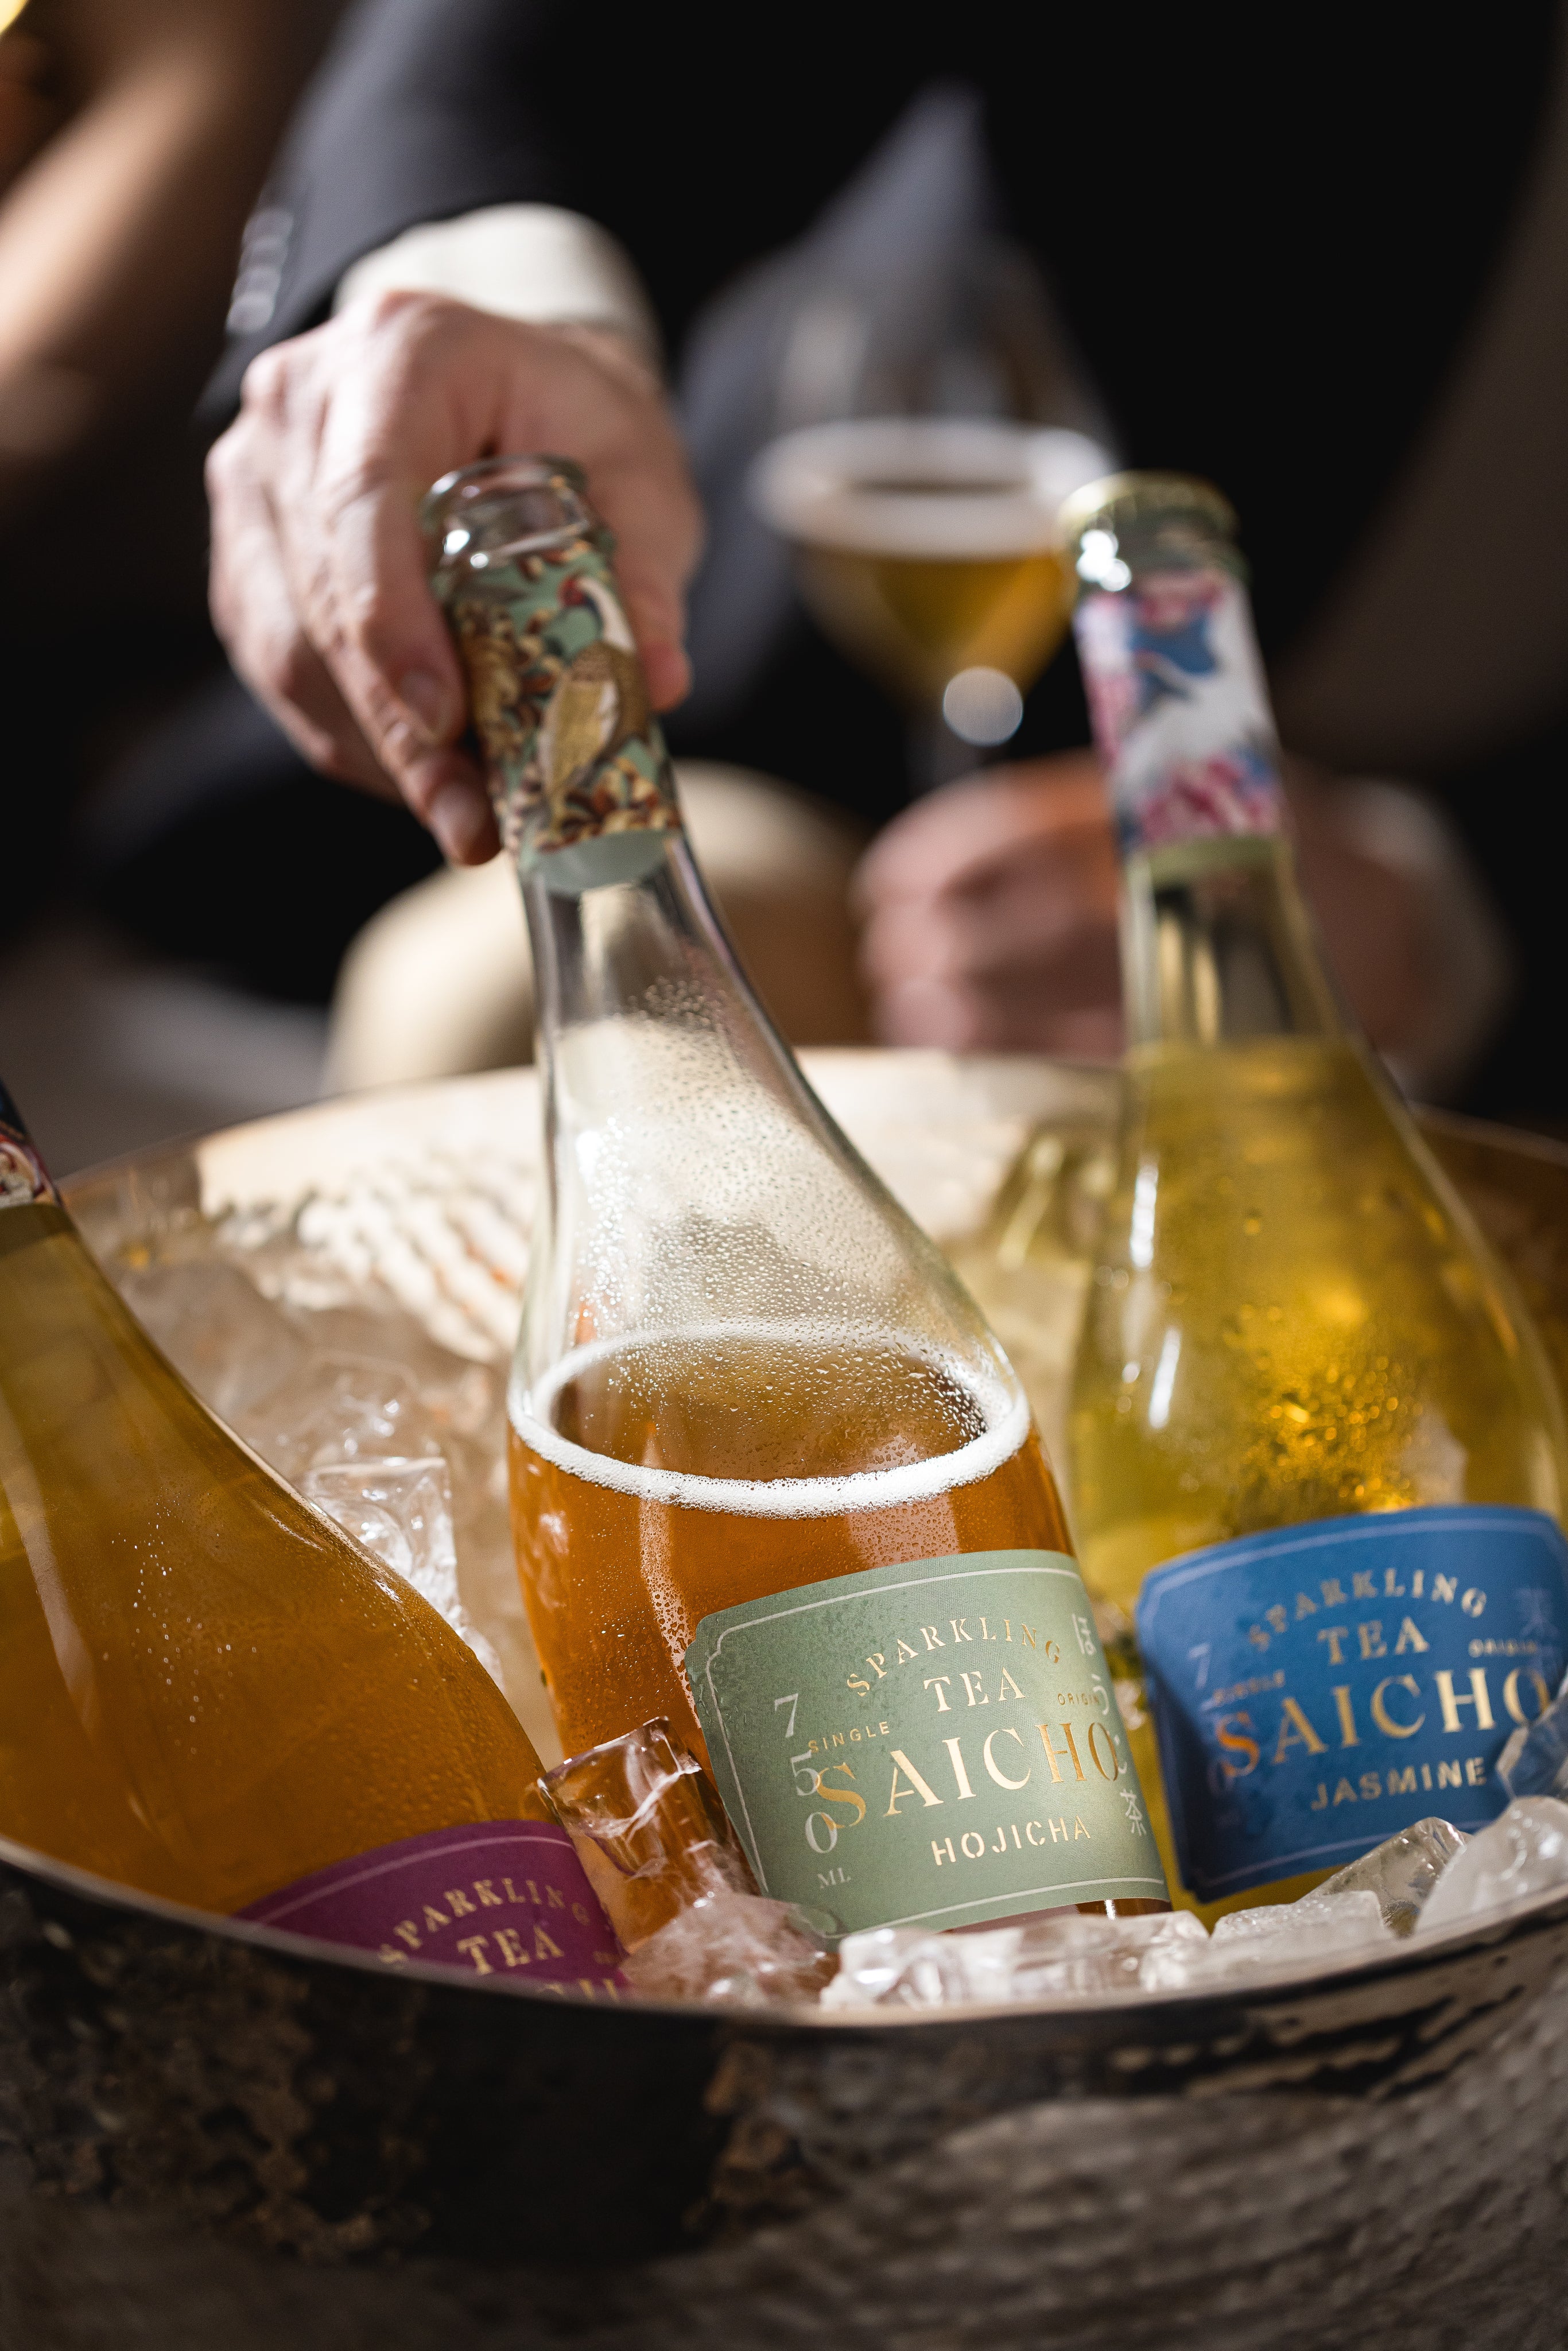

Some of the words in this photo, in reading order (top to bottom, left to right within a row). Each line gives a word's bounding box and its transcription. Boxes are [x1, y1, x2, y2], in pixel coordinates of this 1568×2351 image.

[1249, 1568, 1487, 1652] SPARKLING
[847, 1617, 1060, 1697] SPARKLING
[1317, 1616, 1430, 1665] TEA
[923, 1667, 1026, 1713] TEA
[1057, 1691, 1100, 1706] ORIGIN
[808, 1721, 890, 1753] SINGLE
[1214, 1667, 1551, 1779] SAICHO
[814, 1722, 1119, 1830] SAICHO
[1310, 1756, 1487, 1811] JASMINE
[930, 1815, 1091, 1866] HOJICHA
[457, 1925, 565, 1975] TEA
